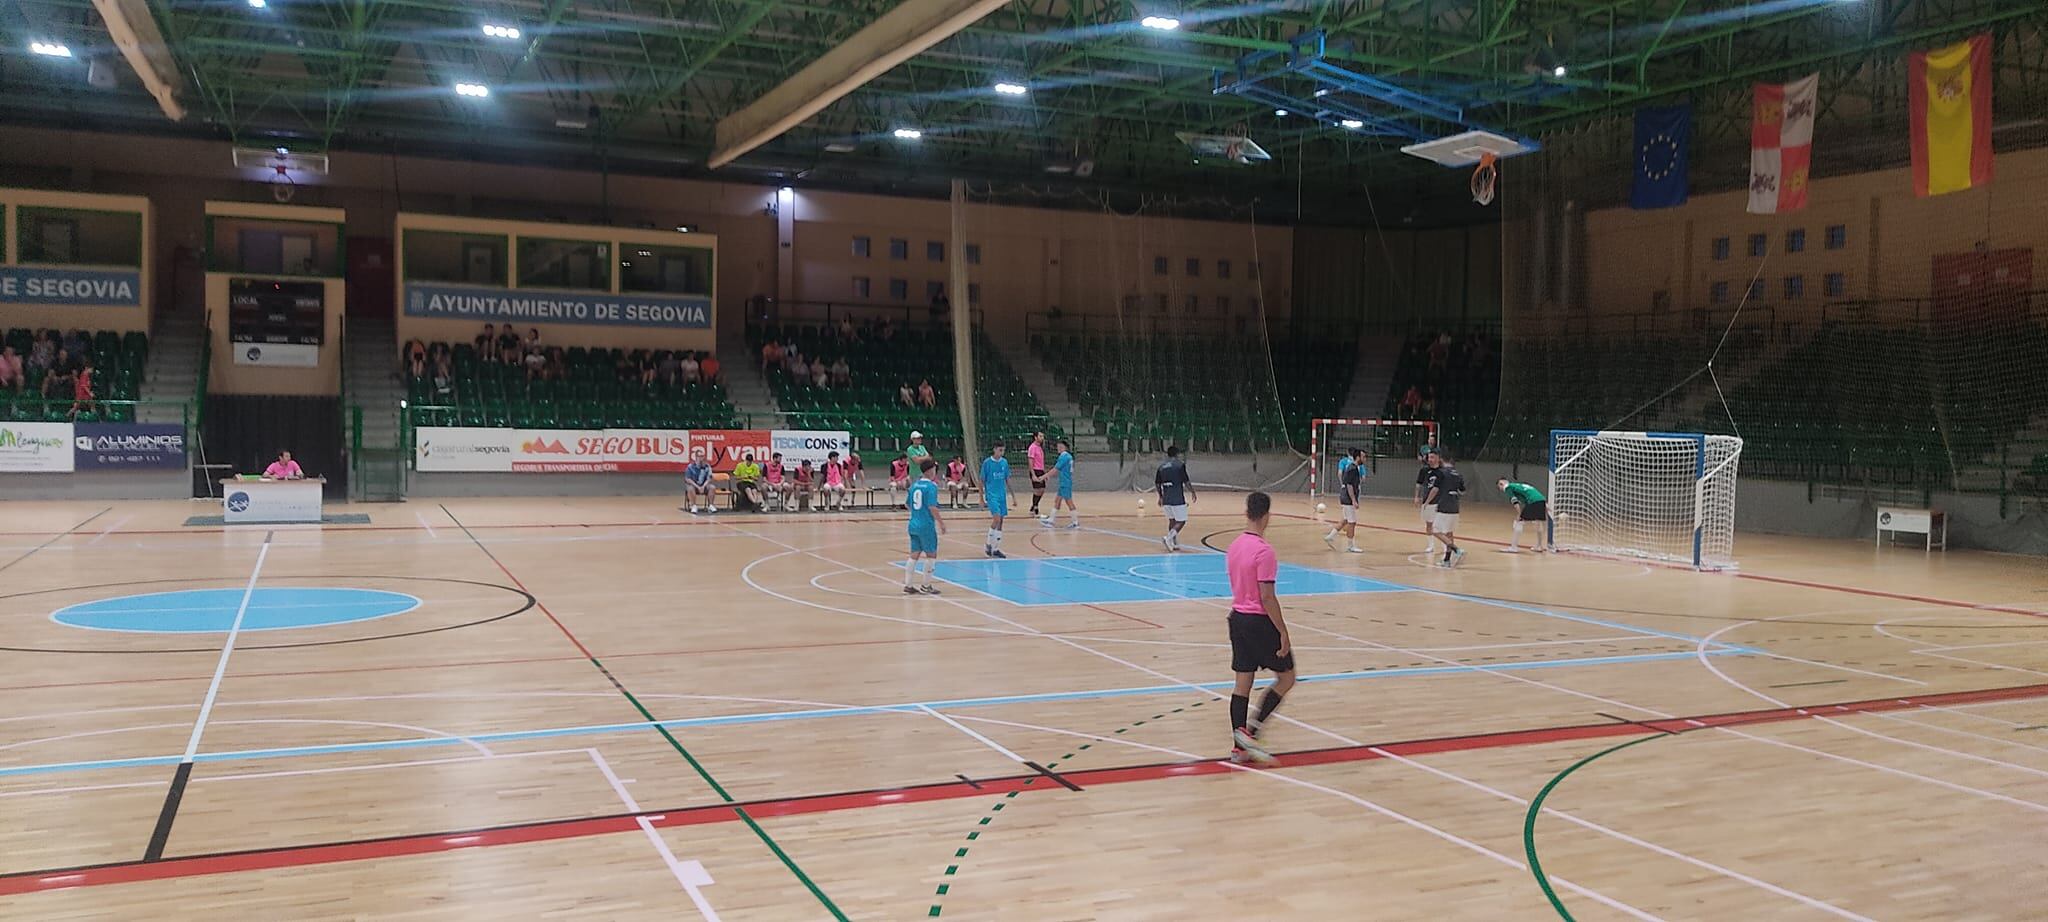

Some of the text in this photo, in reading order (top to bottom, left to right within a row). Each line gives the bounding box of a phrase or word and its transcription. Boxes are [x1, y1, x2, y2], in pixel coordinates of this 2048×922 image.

[0, 277, 132, 299] E SEGOVIA
[428, 294, 705, 322] AYUNTAMIENTO DE SEGOVIA
[97, 435, 183, 445] ALUMINIOS
[575, 437, 684, 455] SEGOBUS
[774, 437, 838, 450] TECNICONS
[912, 489, 922, 510] 9
